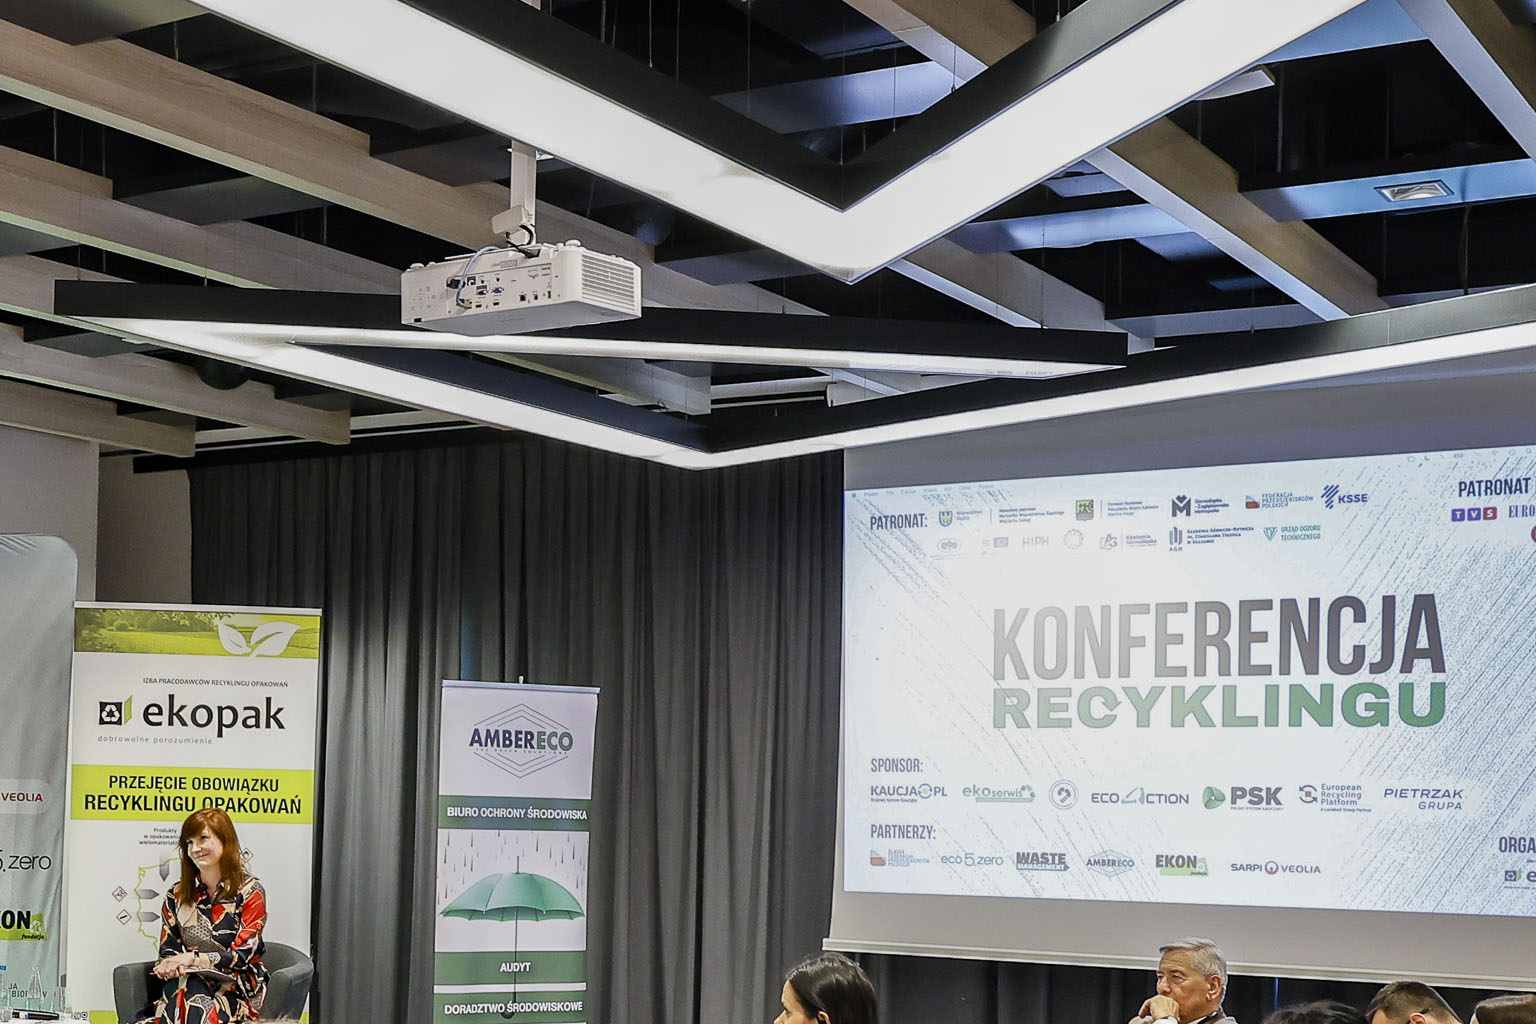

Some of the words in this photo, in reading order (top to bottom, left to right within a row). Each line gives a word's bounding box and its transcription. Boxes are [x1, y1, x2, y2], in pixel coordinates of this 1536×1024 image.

[1458, 477, 1531, 498] PATRONAT
[1338, 494, 1368, 503] KSSE
[1509, 505, 1536, 518] EURO
[870, 513, 927, 530] PATRONAT:
[994, 594, 1446, 681] KONFERENCJA
[993, 682, 1446, 729] RECYKLINGU
[143, 694, 285, 738] ekopak
[469, 728, 573, 751] AMBERECO
[871, 758, 923, 772] SPONSOR:
[109, 775, 187, 793] PRZEJĘCIE
[192, 778, 279, 795] OBOWIĄZKU
[1, 793, 43, 802] VEOLIA
[1230, 787, 1283, 805] PSK
[1321, 791, 1361, 799] Recycling
[1384, 789, 1464, 799] PIETRZAK
[85, 794, 196, 812] RECYKLINGU
[202, 795, 301, 814] OPAKOWAŃ
[1418, 802, 1462, 810] GRUPA
[447, 807, 478, 817] BIURO
[480, 807, 525, 818] OCHRONY
[527, 806, 587, 820] ŚRODOWISKA
[871, 824, 936, 840] PARTNERZY:
[1499, 836, 1536, 853] ORGA
[1016, 852, 1066, 864] WASTE
[1086, 859, 1135, 868] AMBERECO
[1156, 855, 1197, 868] EKON
[1231, 864, 1262, 872] SARPI
[1281, 865, 1321, 874] VEOLIA
[500, 962, 531, 972] AUDYT
[444, 1003, 505, 1015] DORADZTWO
[507, 1000, 582, 1013] ŚRODOWISKOWE
